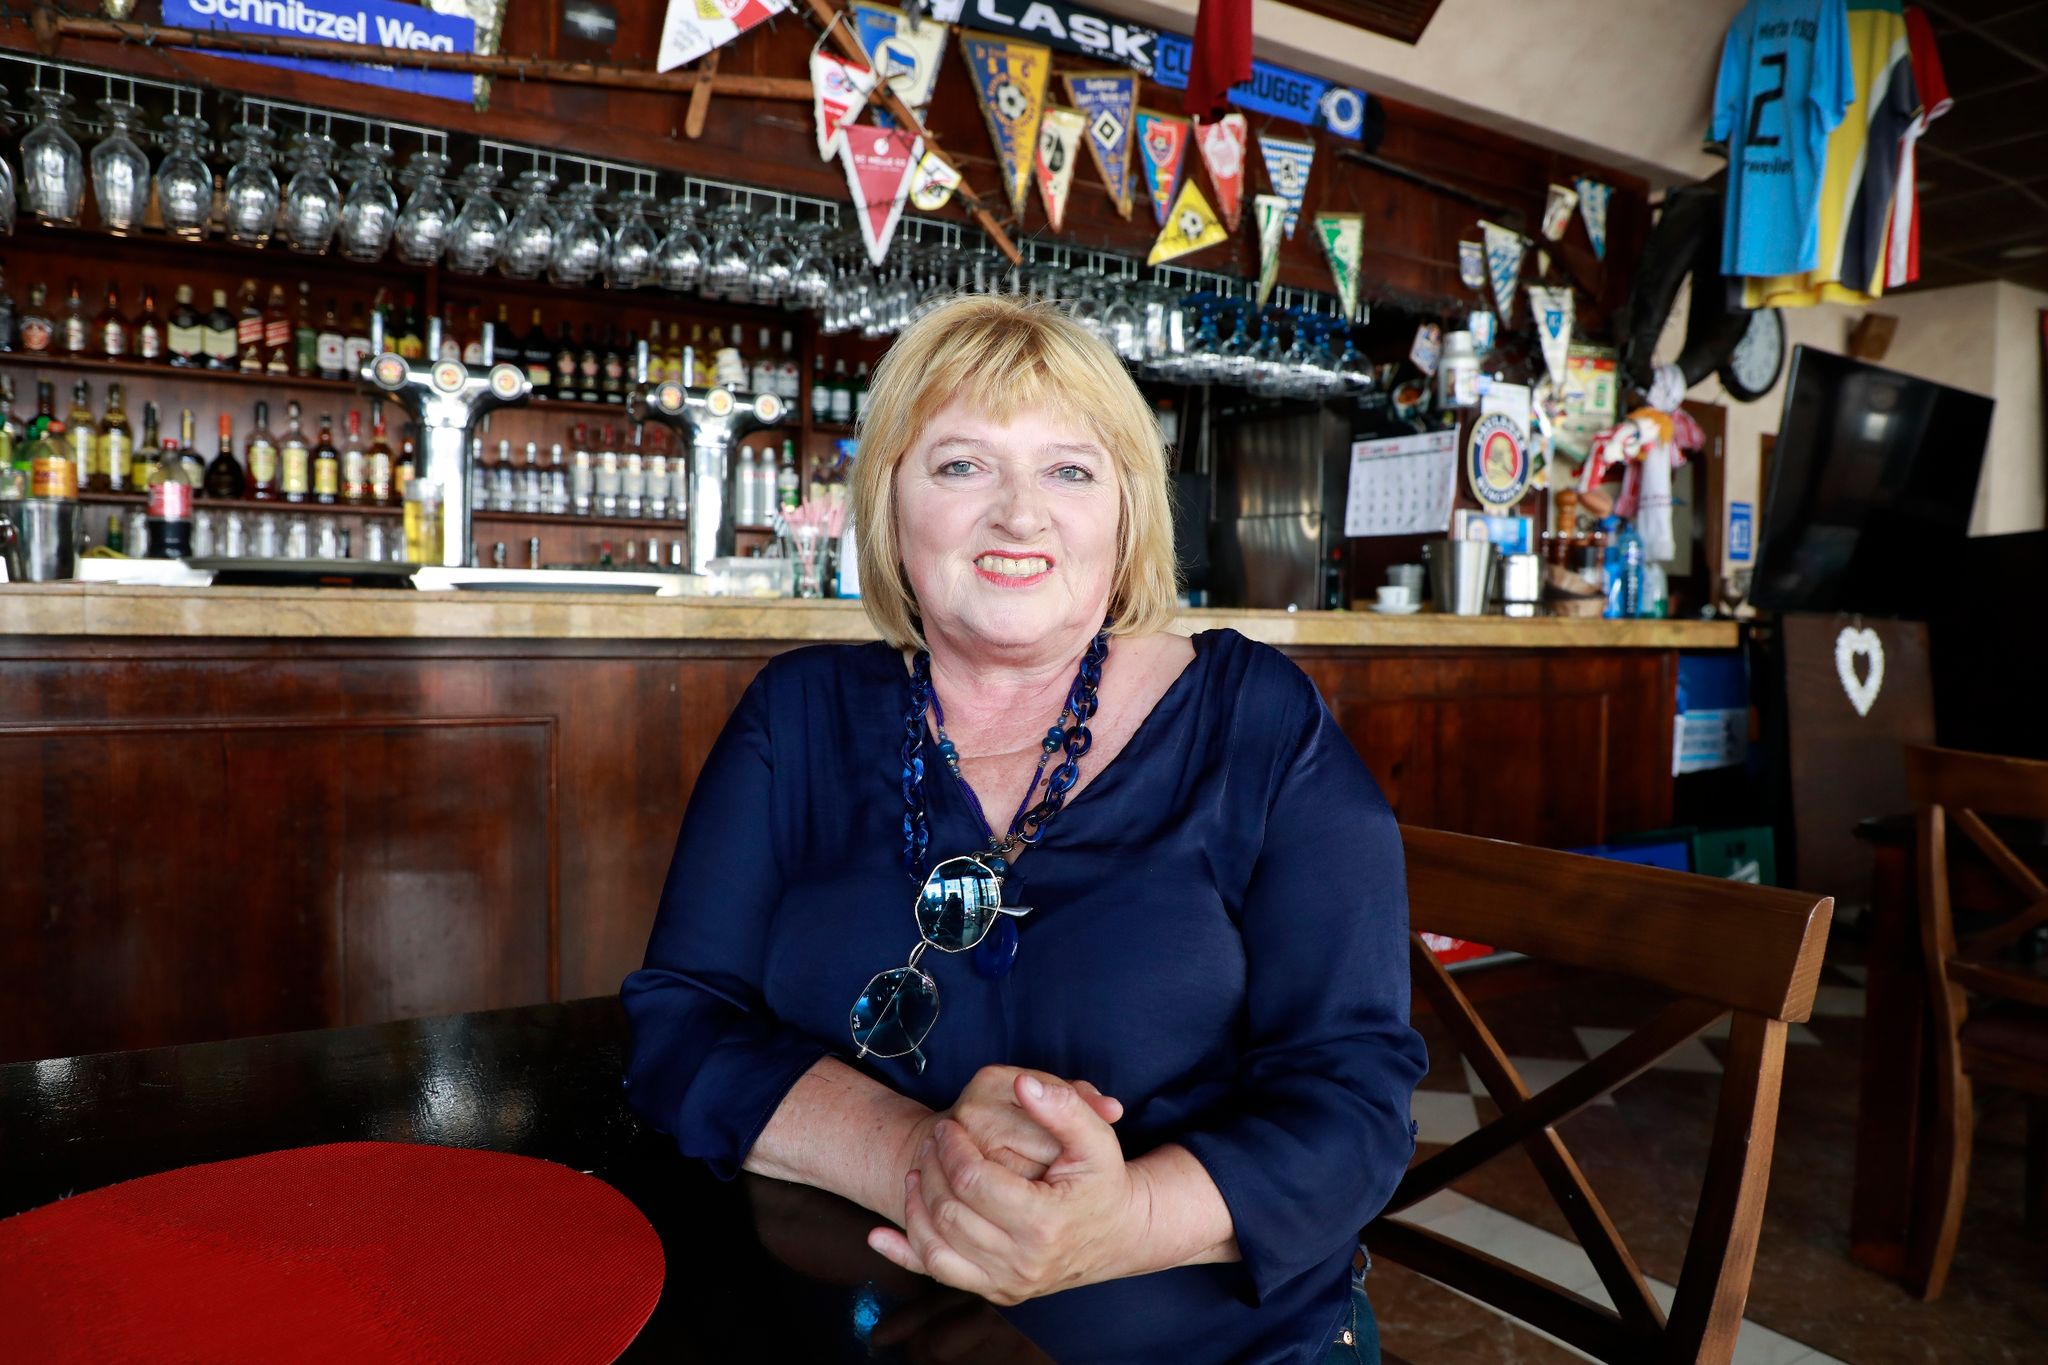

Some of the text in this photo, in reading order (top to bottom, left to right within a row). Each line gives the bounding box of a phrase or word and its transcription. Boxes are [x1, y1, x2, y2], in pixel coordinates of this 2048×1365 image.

[977, 0, 1151, 65] LASK
[1163, 44, 1190, 76] CL
[1233, 69, 1312, 111] RUGGE
[1746, 52, 1788, 146] 2
